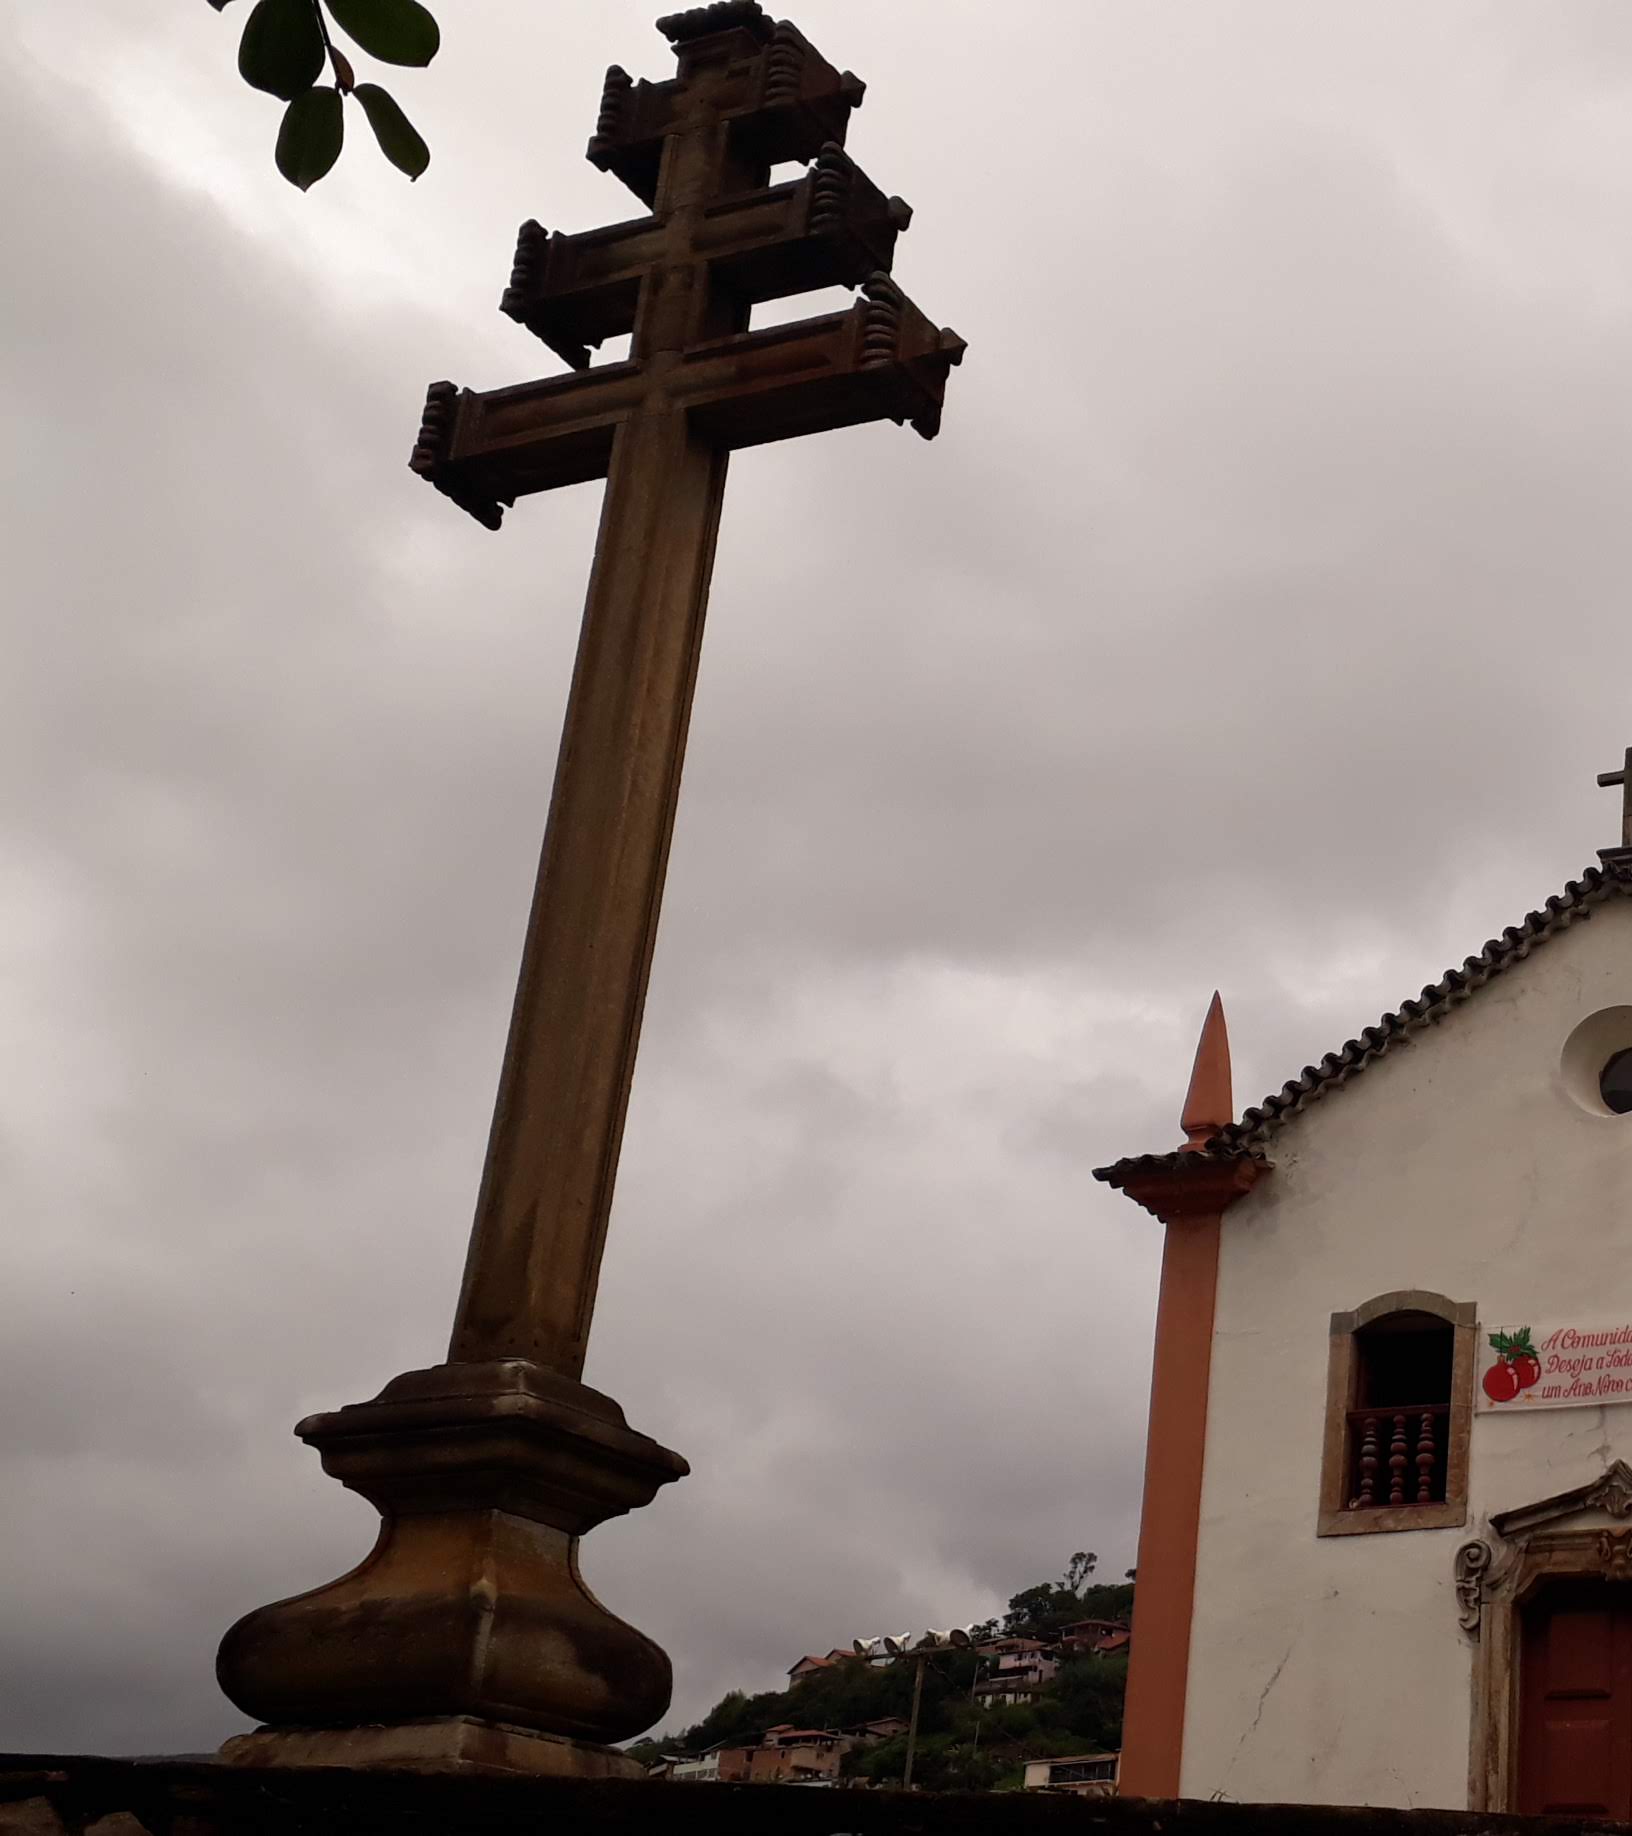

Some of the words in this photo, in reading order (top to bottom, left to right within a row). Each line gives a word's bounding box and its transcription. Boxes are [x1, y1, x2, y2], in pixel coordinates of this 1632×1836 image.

[1541, 1328, 1564, 1351] A
[1544, 1354, 1593, 1379] Deseja
[1596, 1356, 1605, 1370] a
[1541, 1384, 1562, 1399] um
[1562, 1377, 1593, 1398] Ano
[1591, 1373, 1624, 1396] Novo
